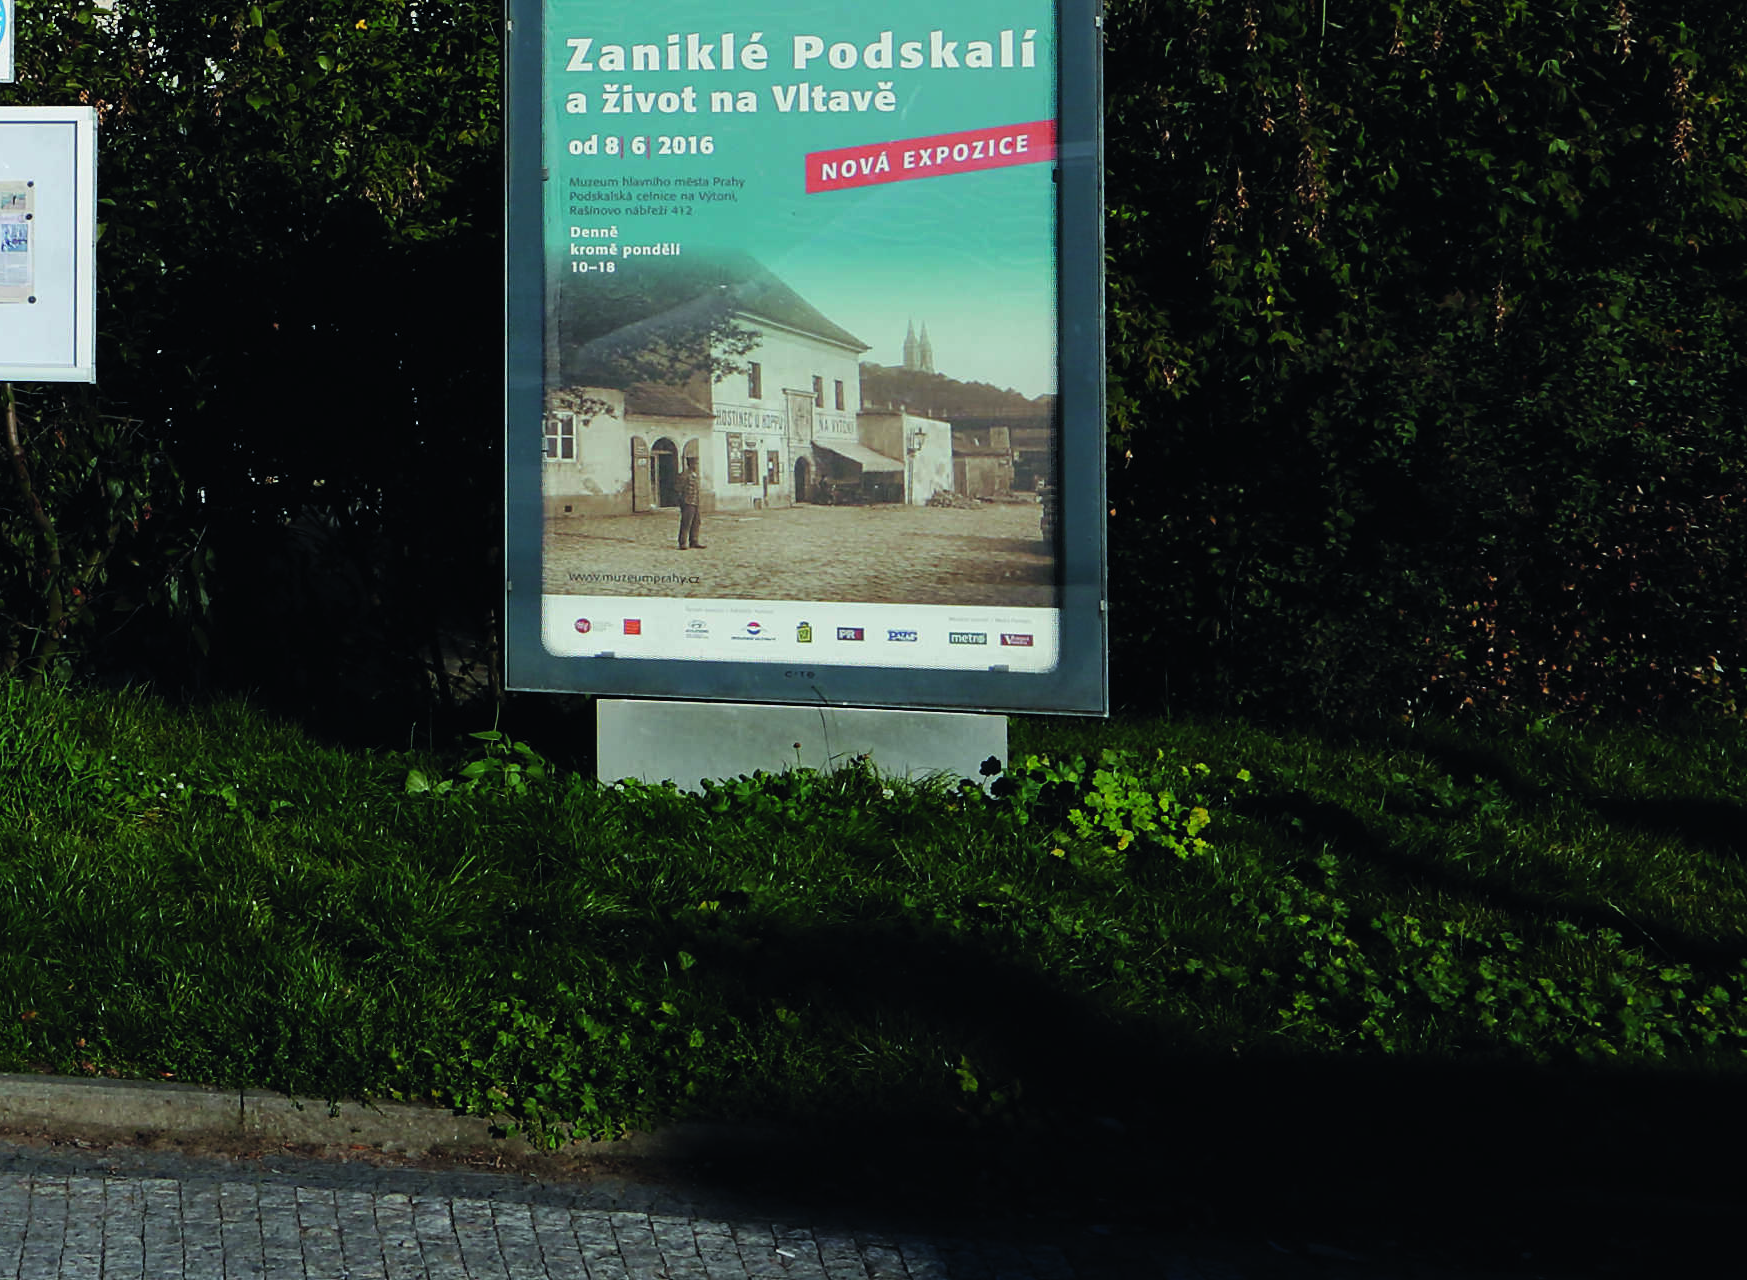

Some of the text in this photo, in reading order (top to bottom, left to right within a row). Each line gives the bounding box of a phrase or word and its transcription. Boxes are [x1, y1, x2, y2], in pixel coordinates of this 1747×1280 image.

[566, 29, 1037, 71] Zaniklé Podskalí
[566, 82, 896, 113] a život na Vltavě
[569, 135, 598, 154] od
[658, 136, 714, 154] 2016
[821, 135, 1028, 181] NOVÁ EXPOZICE
[569, 177, 618, 187] Muzeum
[713, 176, 745, 188] Prahy
[681, 193, 695, 202] na
[671, 206, 693, 216] 412
[570, 225, 619, 238] Denně
[570, 243, 618, 255] kromě
[569, 572, 700, 585] www.muzeumprahy.cz
